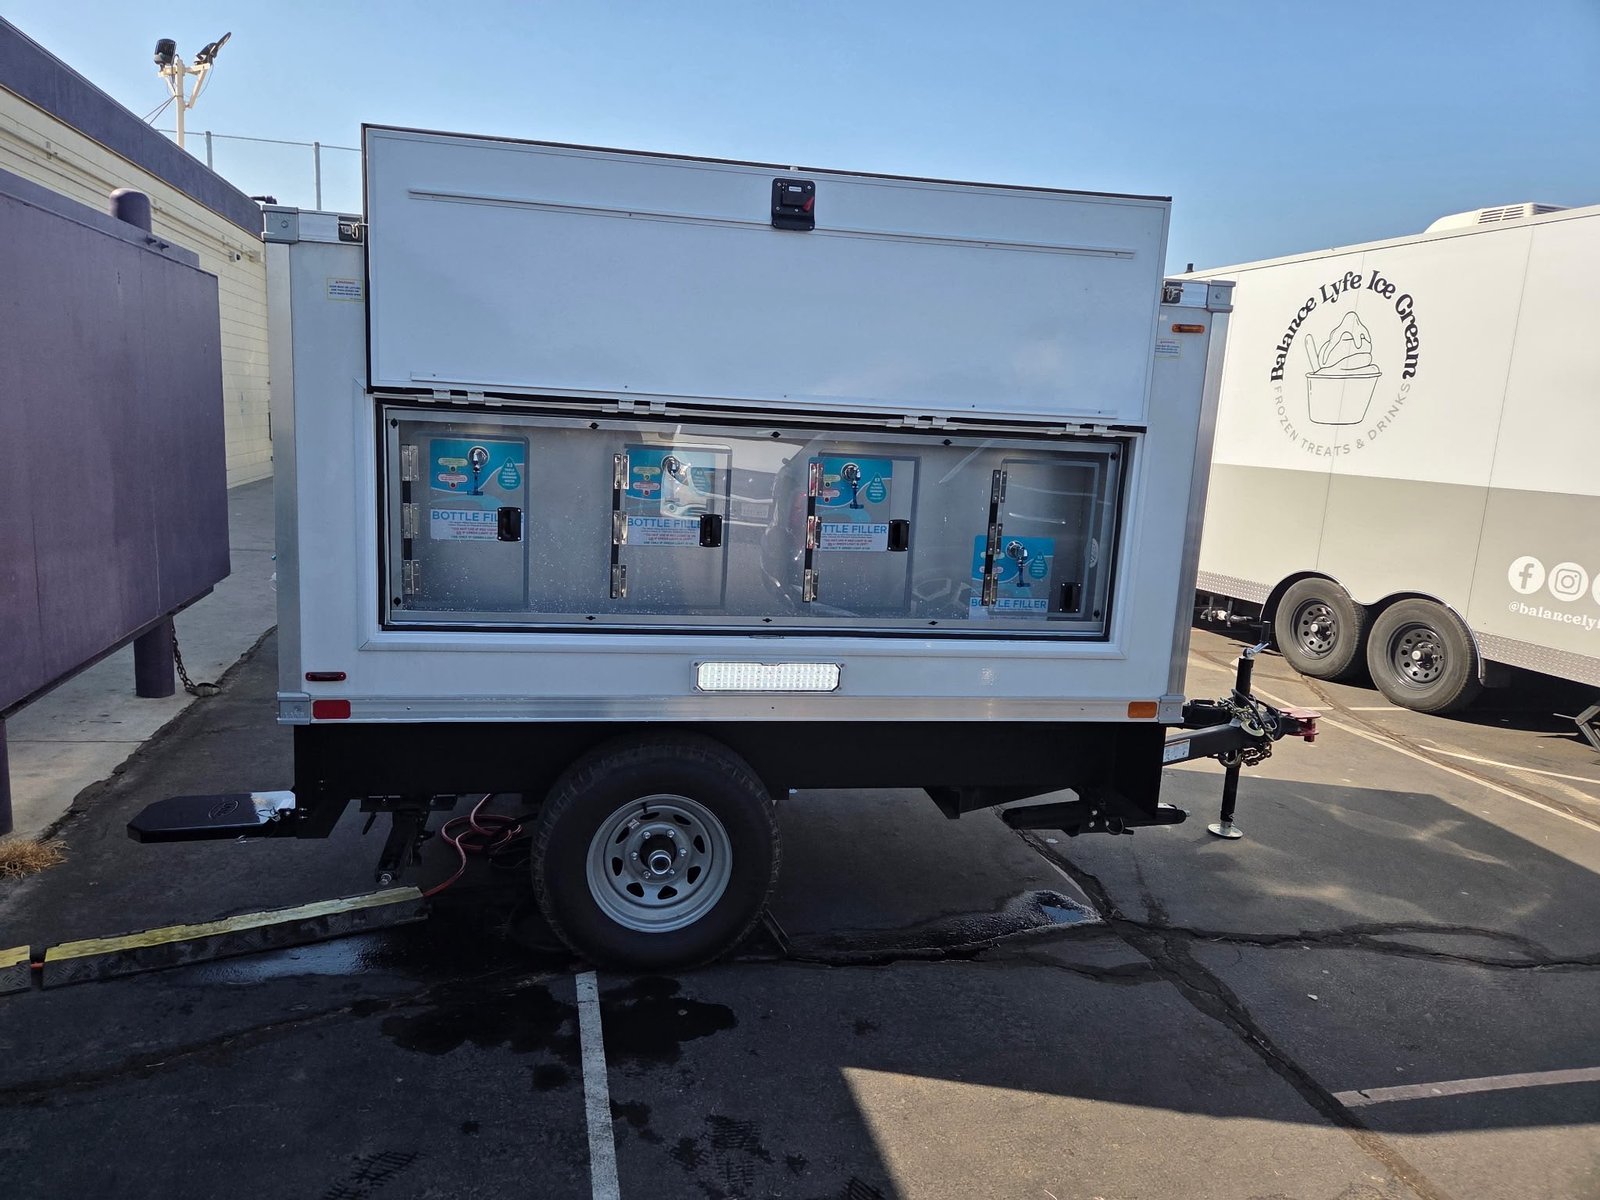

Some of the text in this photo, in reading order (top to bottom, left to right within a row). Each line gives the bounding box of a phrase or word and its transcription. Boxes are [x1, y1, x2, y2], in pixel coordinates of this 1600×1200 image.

[1270, 269, 1420, 382] Balance Lyfe Ice Cream
[1274, 382, 1411, 457] FROZEN TREATS & DRINKS
[432, 510, 479, 522] BOTTLE
[627, 517, 670, 528] BOTTLE
[821, 524, 887, 534] TTLE FILLER
[1013, 599, 1047, 609] FILLER
[1508, 601, 1600, 631] @balancely
